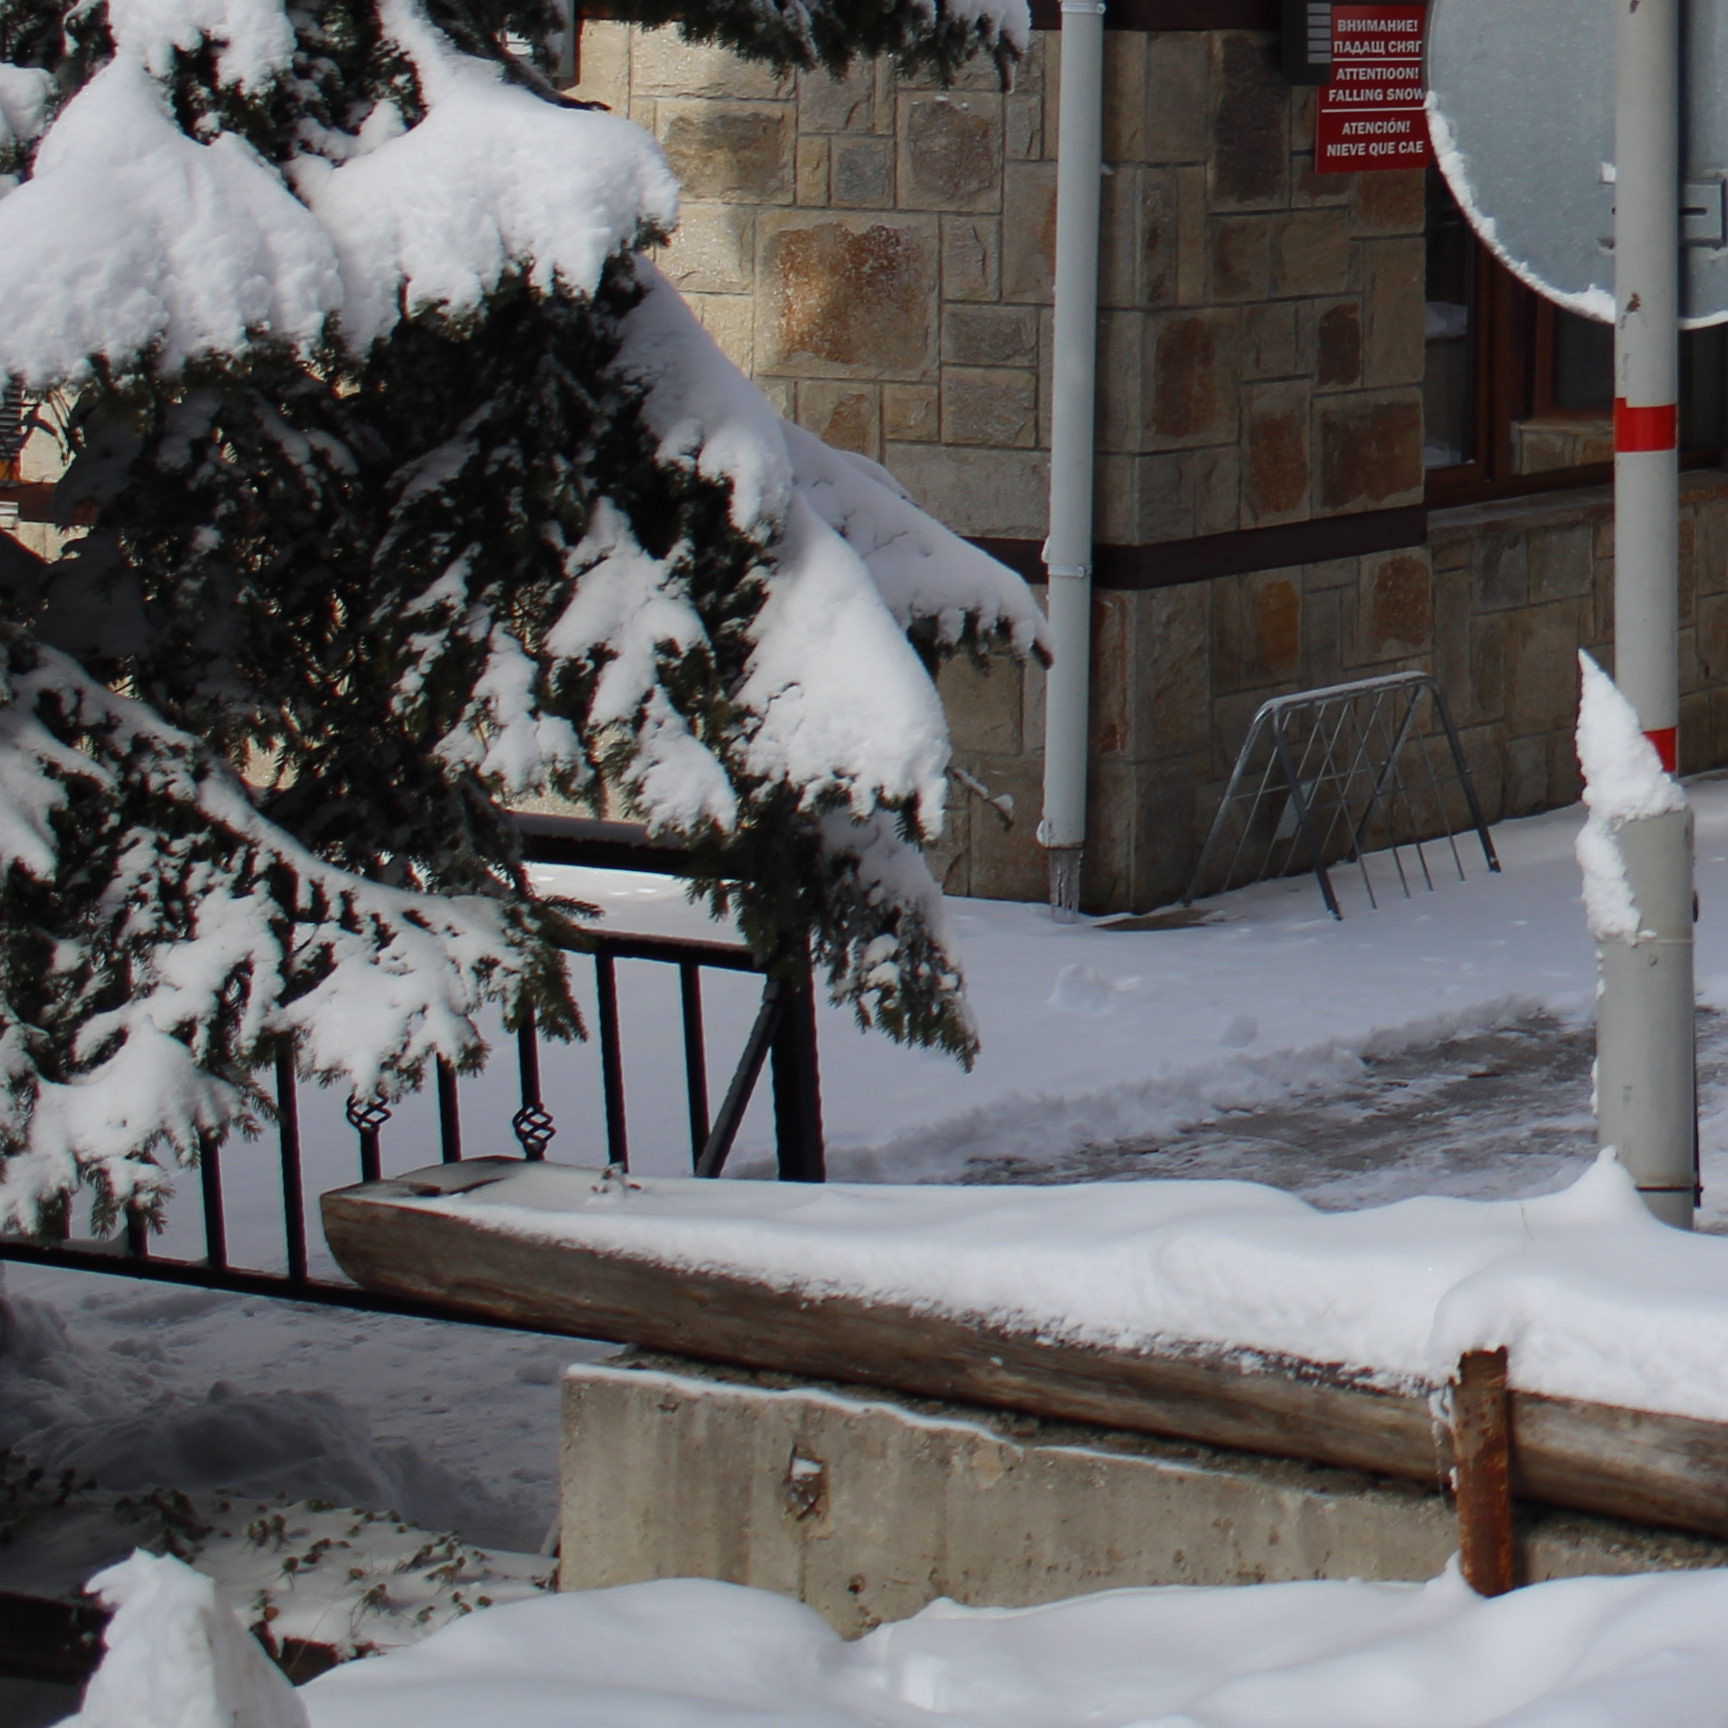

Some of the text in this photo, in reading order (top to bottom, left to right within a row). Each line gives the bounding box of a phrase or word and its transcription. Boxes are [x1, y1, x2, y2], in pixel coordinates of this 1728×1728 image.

[1337, 19, 1418, 32] ВНИМАНИЕ!
[1333, 40, 1422, 55] ПАДАЩ СНЯГ
[1336, 67, 1419, 80] ATTENTIOON!
[1328, 88, 1425, 102] FALLING SNOW
[1342, 117, 1411, 135] ATENCIÓN!
[1326, 141, 1424, 157] NIEVE QUE CAE
